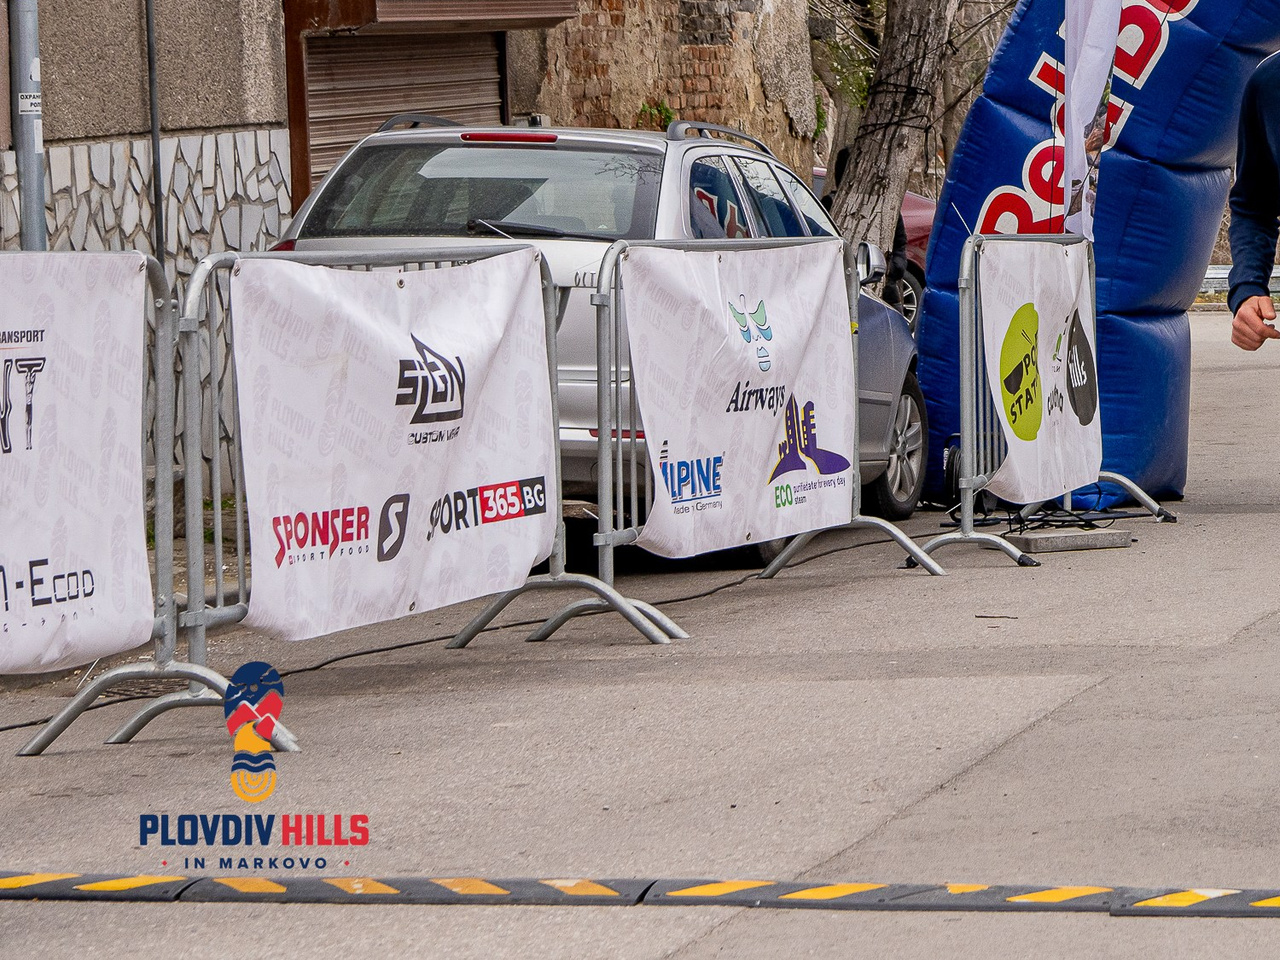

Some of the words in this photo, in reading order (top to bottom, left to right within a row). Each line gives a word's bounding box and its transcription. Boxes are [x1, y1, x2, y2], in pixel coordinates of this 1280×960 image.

[725, 381, 786, 417] Airways
[695, 500, 723, 512] Germany
[774, 483, 793, 509] ECO
[836, 475, 846, 487] day
[272, 505, 370, 570] SPONSER
[339, 545, 370, 557] FOOD
